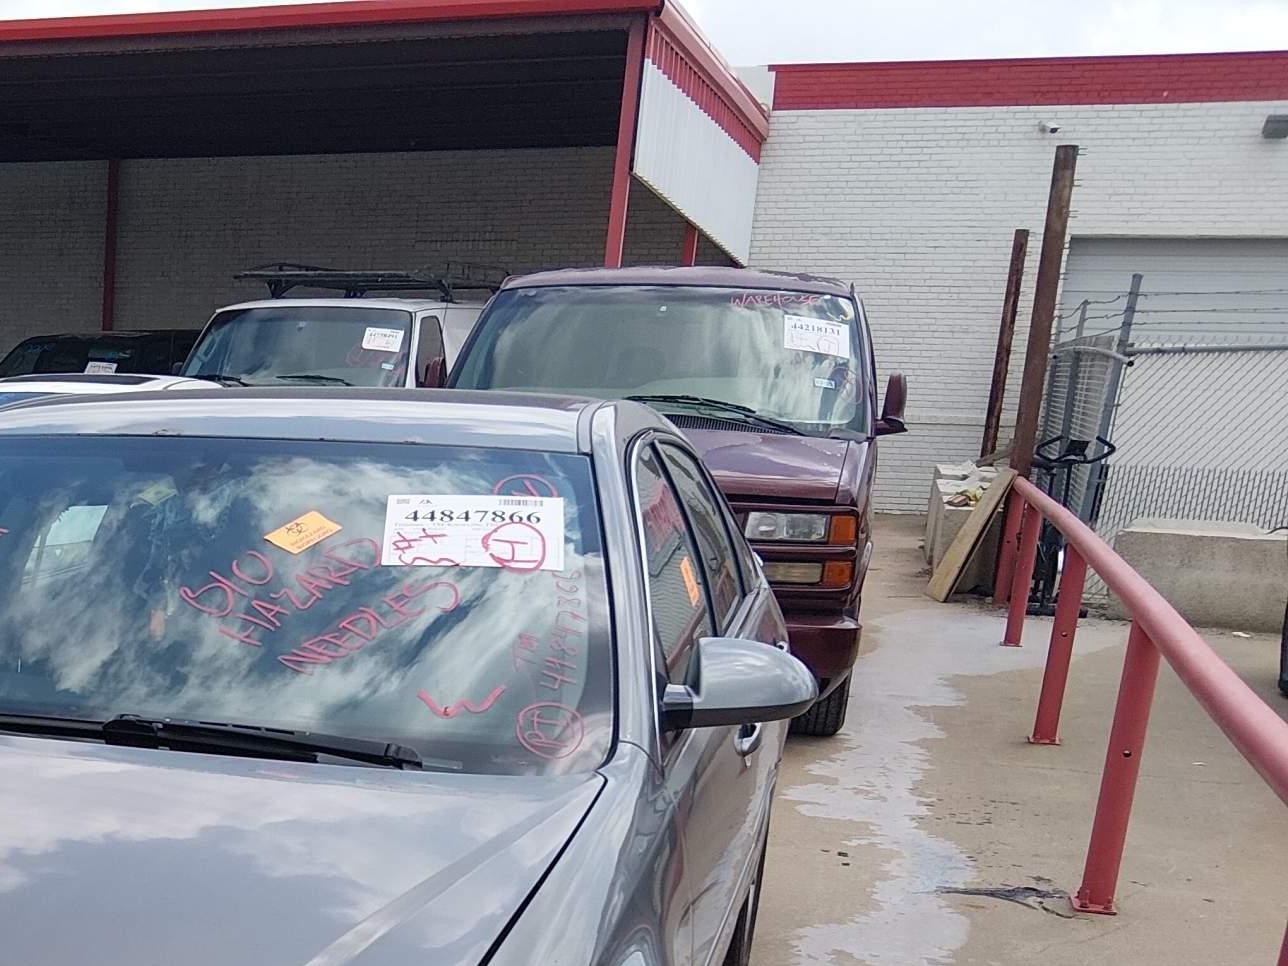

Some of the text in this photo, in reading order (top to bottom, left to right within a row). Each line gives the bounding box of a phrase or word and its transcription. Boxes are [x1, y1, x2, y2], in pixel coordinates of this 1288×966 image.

[404, 509, 541, 525] 44847866
[179, 550, 273, 617] BIO
[219, 537, 381, 647] HAZARD
[278, 581, 459, 675] NEEDLES
